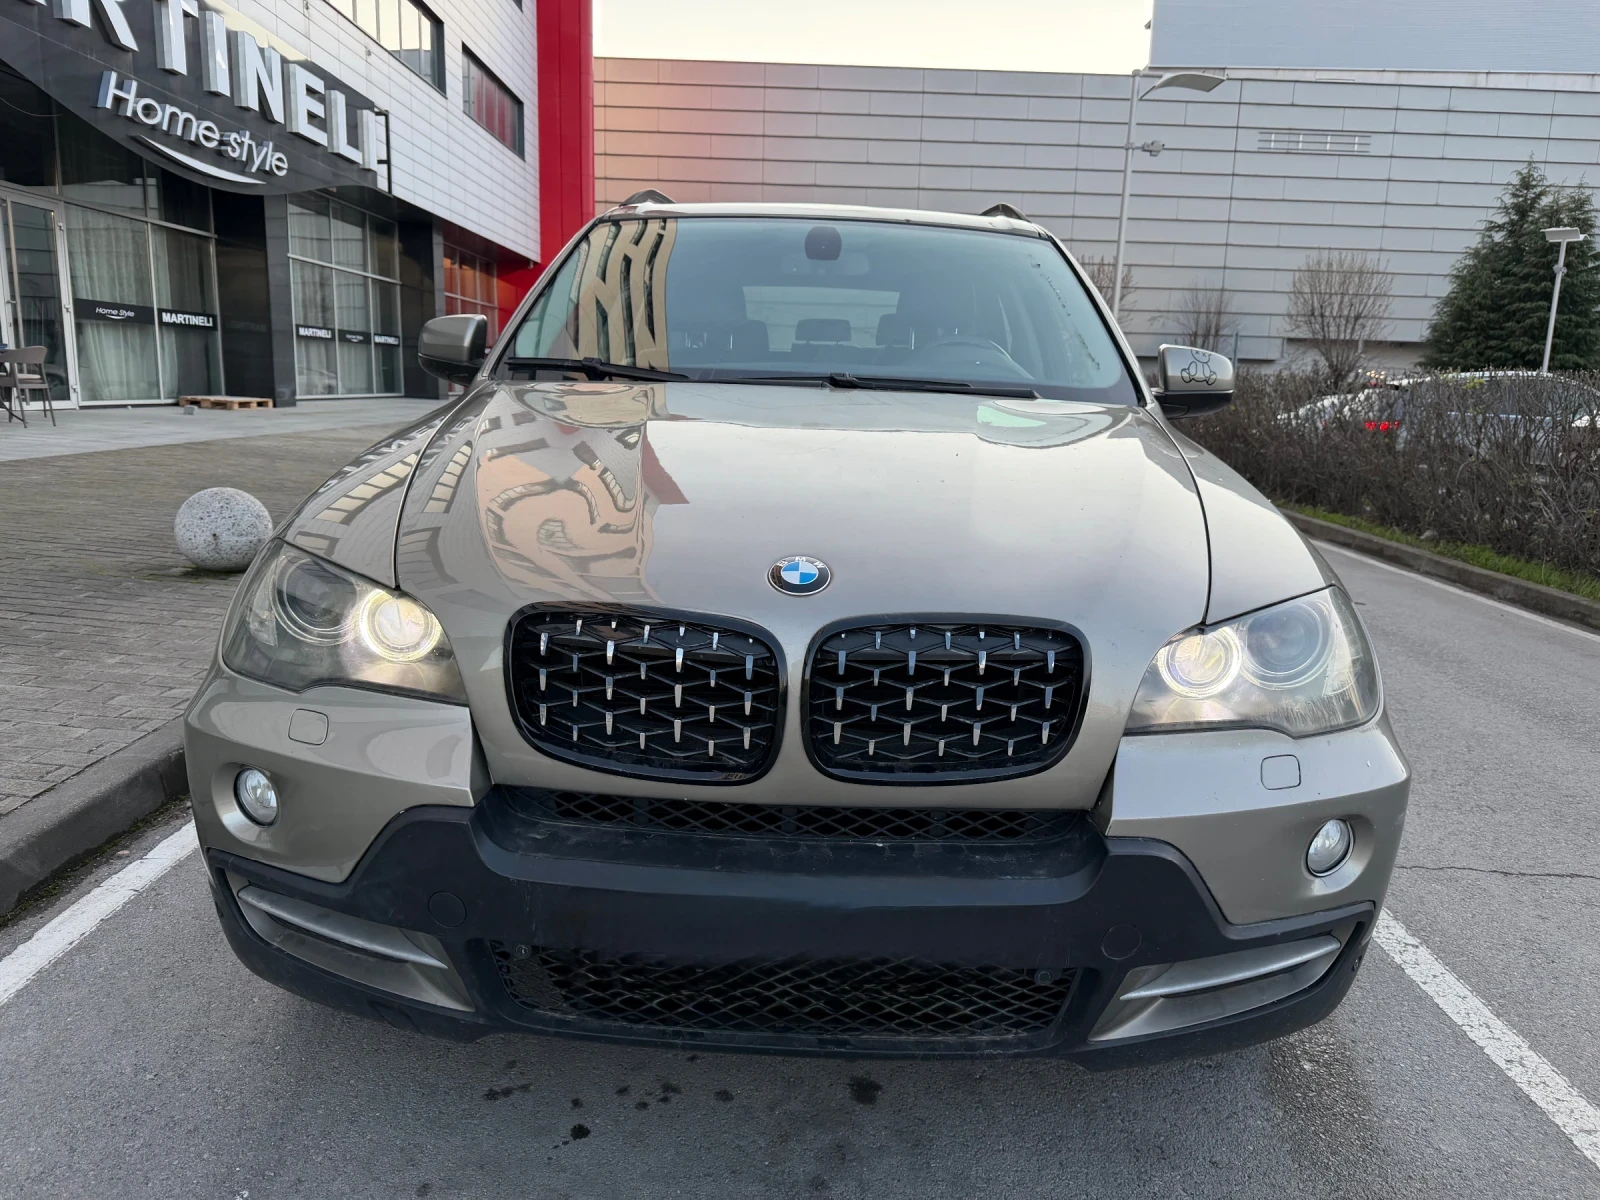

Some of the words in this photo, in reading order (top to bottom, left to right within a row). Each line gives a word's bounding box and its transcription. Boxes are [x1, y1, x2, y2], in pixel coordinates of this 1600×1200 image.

[98, 71, 220, 148] Home
[226, 130, 289, 177] style
[95, 307, 118, 316] Home
[119, 309, 135, 318] Style
[161, 312, 214, 327] MARTINELI
[298, 327, 332, 339] MARTINELI
[776, 556, 825, 569] BMW
